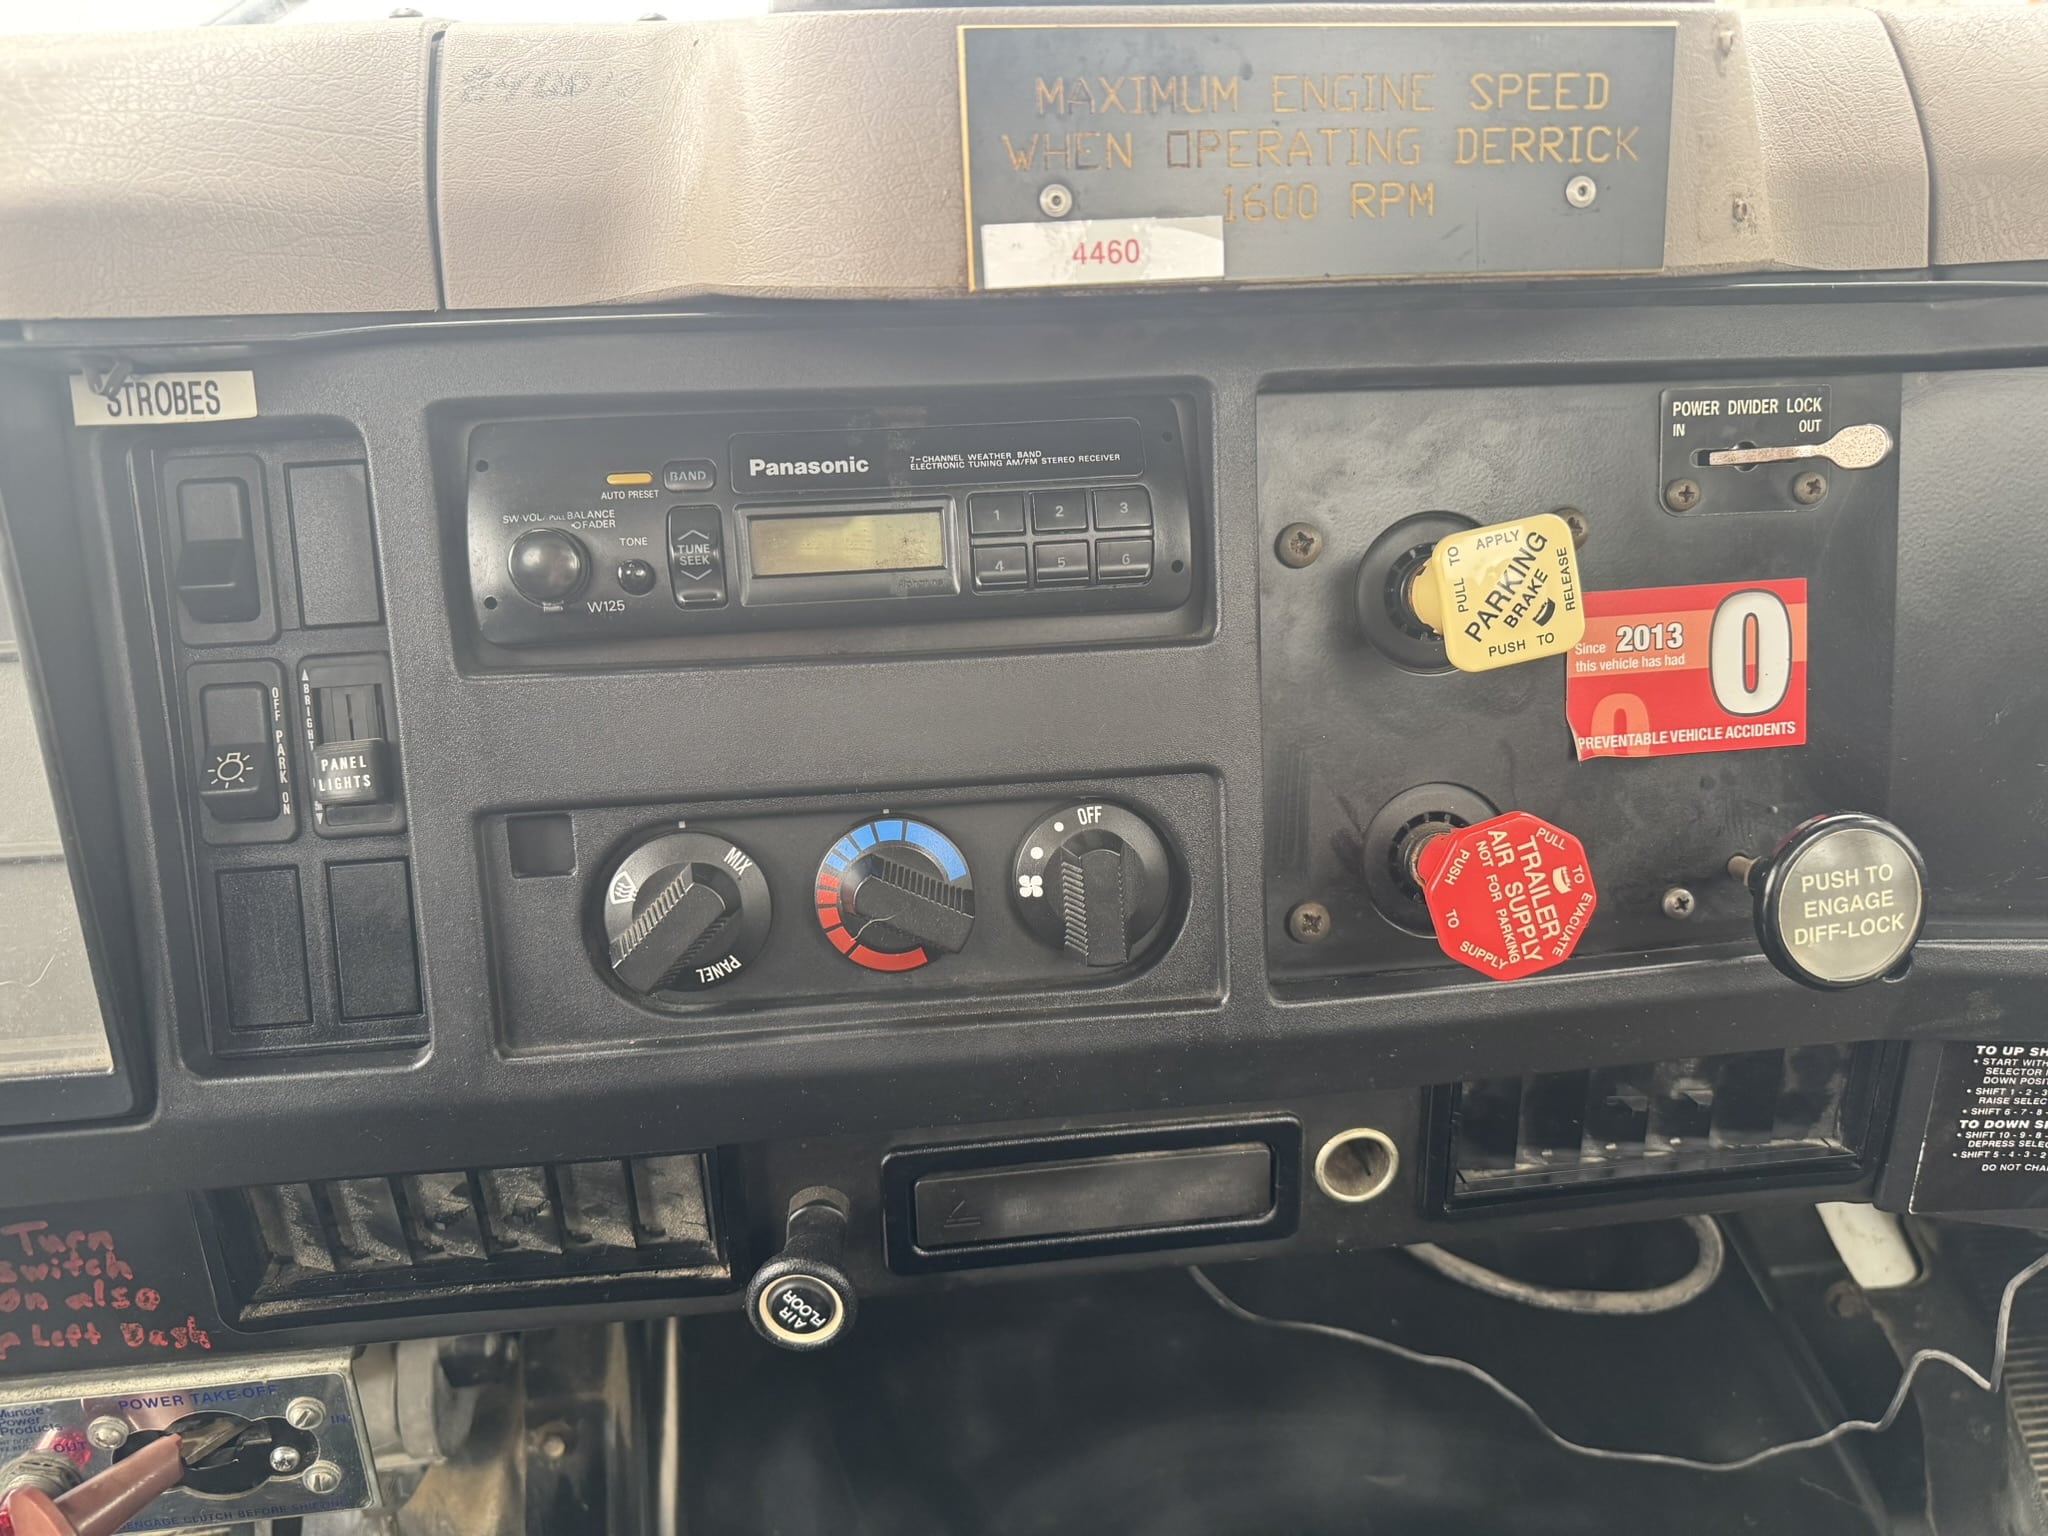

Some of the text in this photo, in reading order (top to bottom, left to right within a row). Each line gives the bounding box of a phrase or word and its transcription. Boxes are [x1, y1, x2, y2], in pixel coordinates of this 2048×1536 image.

[1035, 71, 1610, 115] MAXIMUM ENGINE SPEED
[1001, 125, 1641, 171] WHEN OPERATING DERRICK
[1221, 180, 1436, 224] 1600 RPM
[1072, 238, 1140, 265] 4460
[107, 379, 221, 417] STROBES
[1672, 396, 1822, 417] POWER DIVIDER LOCK
[1672, 423, 1686, 437] IN
[1799, 418, 1822, 433] OUT
[910, 453, 1121, 471] ELECTRONIC TUNING AM/FM STEREO RECEIVER
[968, 451, 1012, 460] WEATHER
[1016, 450, 1042, 458] BAND
[749, 456, 870, 476] Panasonic
[669, 470, 706, 481] BAND
[600, 489, 660, 500] AUTO PRESET
[566, 509, 616, 520] BALANCE
[992, 509, 1001, 521] 1
[1055, 505, 1065, 518] 2
[1119, 502, 1129, 514] 3
[582, 519, 617, 529] FADER
[619, 536, 648, 546] TONE
[676, 543, 711, 554] TUNE
[679, 554, 711, 566] SEEK
[994, 560, 1005, 572] 4
[1057, 557, 1066, 568] 5
[1121, 553, 1131, 565] 6
[1447, 529, 1521, 613] PULL TO APPLY
[1464, 531, 1549, 643] PARKING
[586, 600, 626, 613] W125
[1488, 547, 1576, 657] PUSH TO RELEASE
[1503, 568, 1549, 629] BRAKE
[1574, 622, 1684, 656] Since 2013
[1708, 587, 1793, 718] 0
[1575, 653, 1686, 673] this vehicle has had
[302, 683, 315, 751] BRIGHT
[1578, 720, 1797, 750] PREVENTABLE VEHICLE ACCIDENTS
[271, 687, 291, 815] OFF PARK ON
[321, 755, 367, 771] PANEL
[318, 774, 372, 792] LIGHTS
[1077, 805, 1103, 826] OFF
[723, 846, 753, 876] MIX
[1517, 834, 1561, 940] TRAILER
[1801, 863, 1893, 893] PUSH TO
[1487, 830, 1544, 962] AIR SUPPLY
[1535, 827, 1594, 957] PULL TO EVACUATE
[1444, 848, 1508, 970] PUSH TO SUPPLY
[1475, 840, 1521, 964] NOT FOR PARKING
[1803, 889, 1894, 918] ENGAGE
[1793, 912, 1905, 946] DIFF-LOCK
[695, 954, 743, 984] PANEL
[1976, 1045, 1998, 1055] TO
[2002, 1046, 2025, 1056] UP
[1982, 1057, 2048, 1067] START WITH
[1982, 1076, 2017, 1085] DOWN
[1985, 1067, 2043, 1076] SELECTOR
[1975, 1087, 2007, 1096] SHIFT
[1978, 1097, 2011, 1105] RAISE
[1971, 1107, 2002, 1115] SHIFT
[1960, 1120, 1980, 1129] TO
[1984, 1120, 2030, 1129] DOWN
[1965, 1131, 1996, 1139] SHIFT
[1968, 1140, 2015, 1148] DEPRESS
[1960, 1150, 1990, 1158] SHIFT
[2000, 1163, 2022, 1171] NOT
[0, 1220, 114, 1256] Turn
[65, 1279, 161, 1311] also
[778, 1306, 808, 1329] AIR
[782, 1289, 827, 1328] FLOOR
[32, 1322, 101, 1348] Left
[120, 1316, 211, 1349] Dash
[117, 1395, 185, 1411] POWER
[0, 1423, 63, 1436] Products
[53, 1440, 87, 1453] OUT
[184, 1511, 233, 1525] CLUTCH
[238, 1505, 288, 1519] BEFORE
